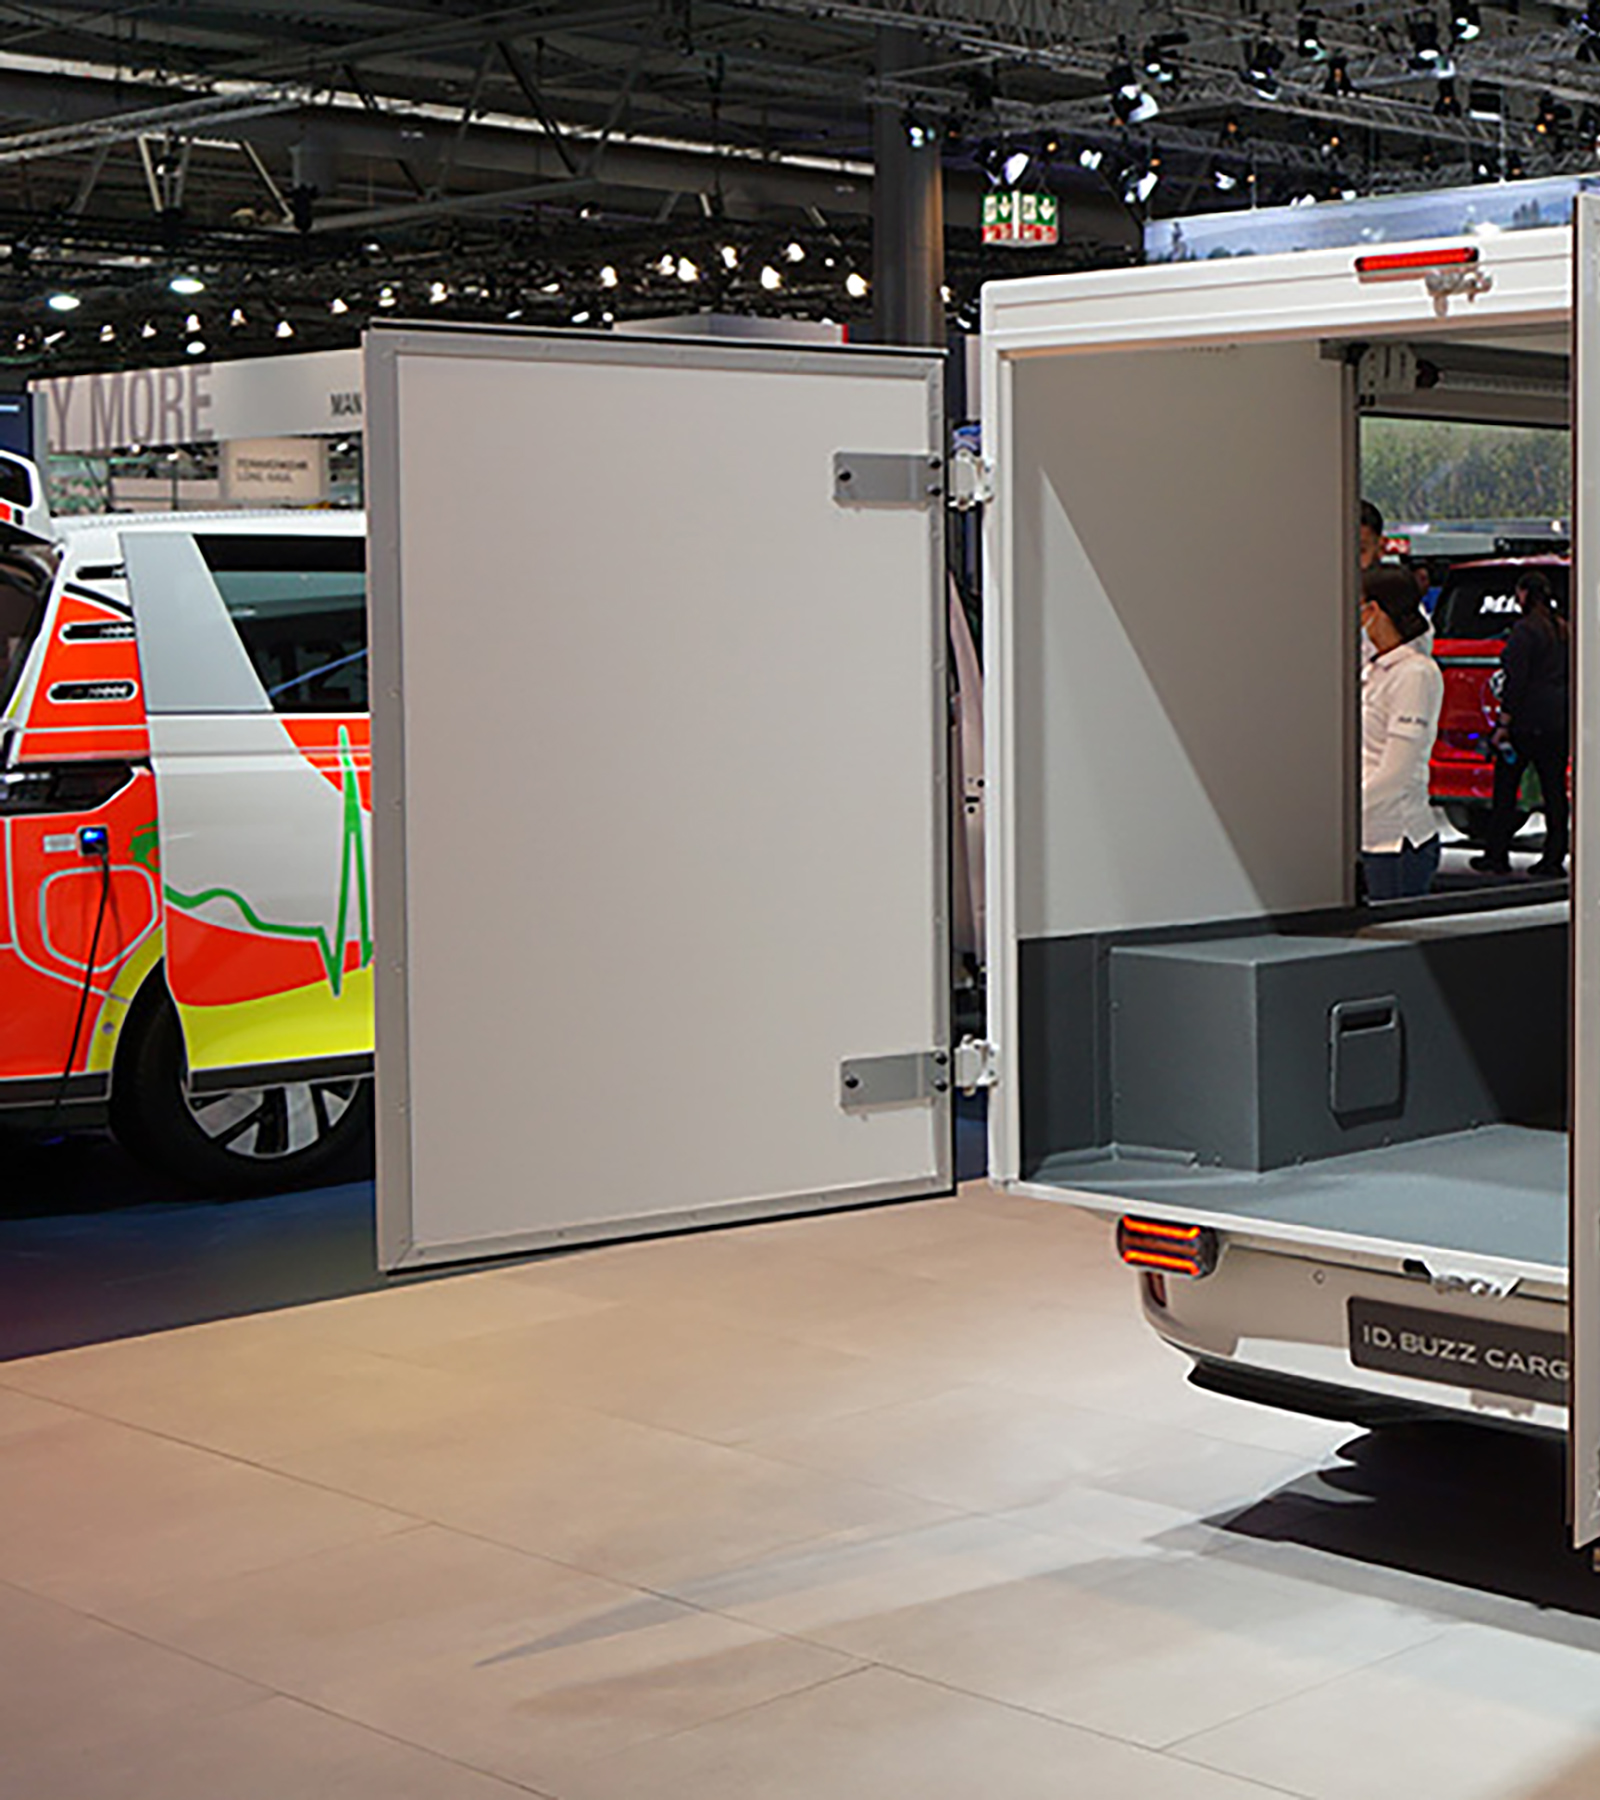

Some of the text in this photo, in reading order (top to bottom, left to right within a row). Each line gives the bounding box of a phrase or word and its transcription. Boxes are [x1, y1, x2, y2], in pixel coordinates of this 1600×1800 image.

[42, 367, 212, 452] Y MORE
[1485, 1350, 1569, 1381] CARG
